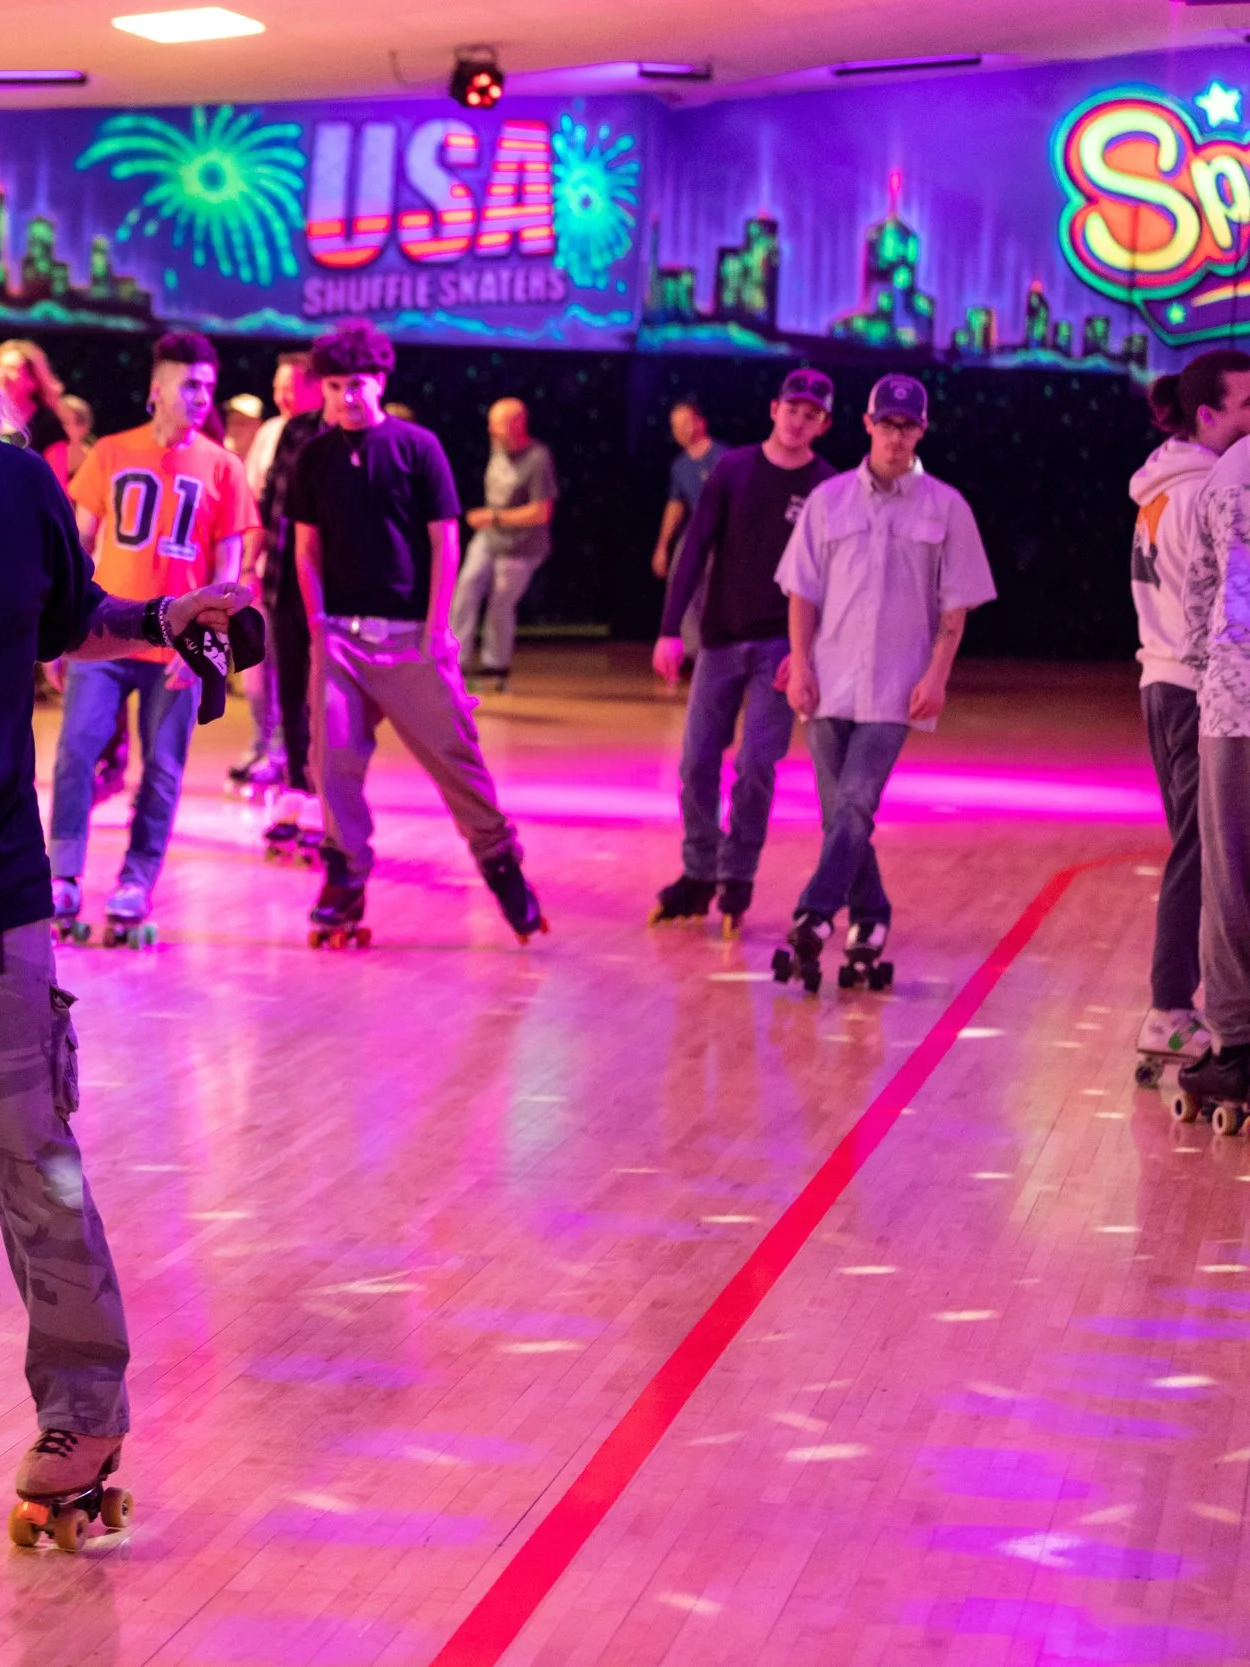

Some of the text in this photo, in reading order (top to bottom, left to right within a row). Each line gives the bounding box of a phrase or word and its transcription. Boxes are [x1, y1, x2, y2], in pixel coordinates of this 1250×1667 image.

[307, 119, 555, 268] USA
[302, 265, 567, 316] SHUFFLE SKATERS
[111, 467, 203, 561] 01
